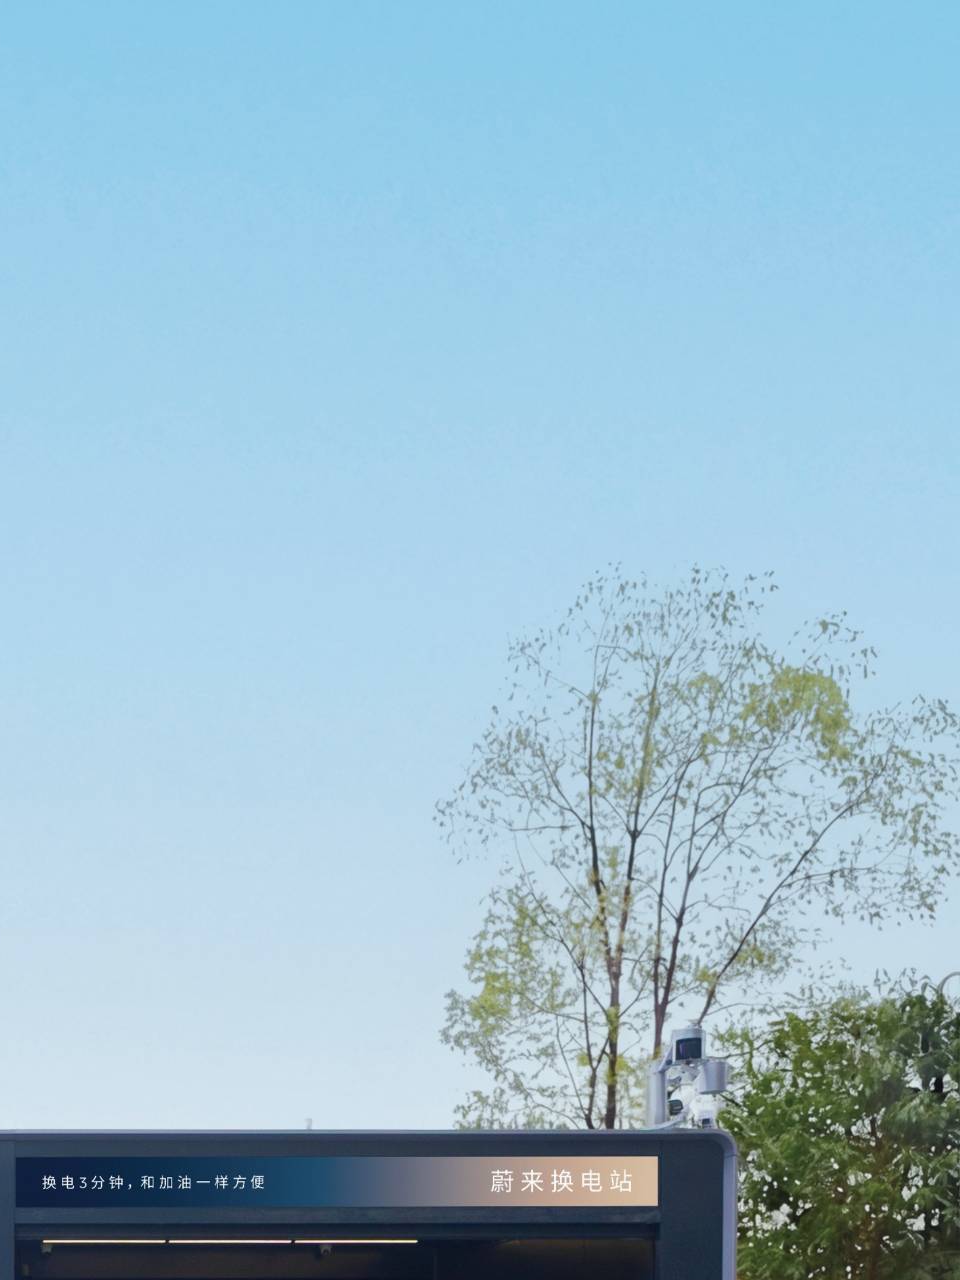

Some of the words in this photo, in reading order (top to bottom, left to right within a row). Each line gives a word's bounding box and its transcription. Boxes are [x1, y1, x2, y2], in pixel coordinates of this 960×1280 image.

[41, 1174, 266, 1191] 换电3分钟，和加油一样方便
[490, 1169, 633, 1193] 蔚来换电站
